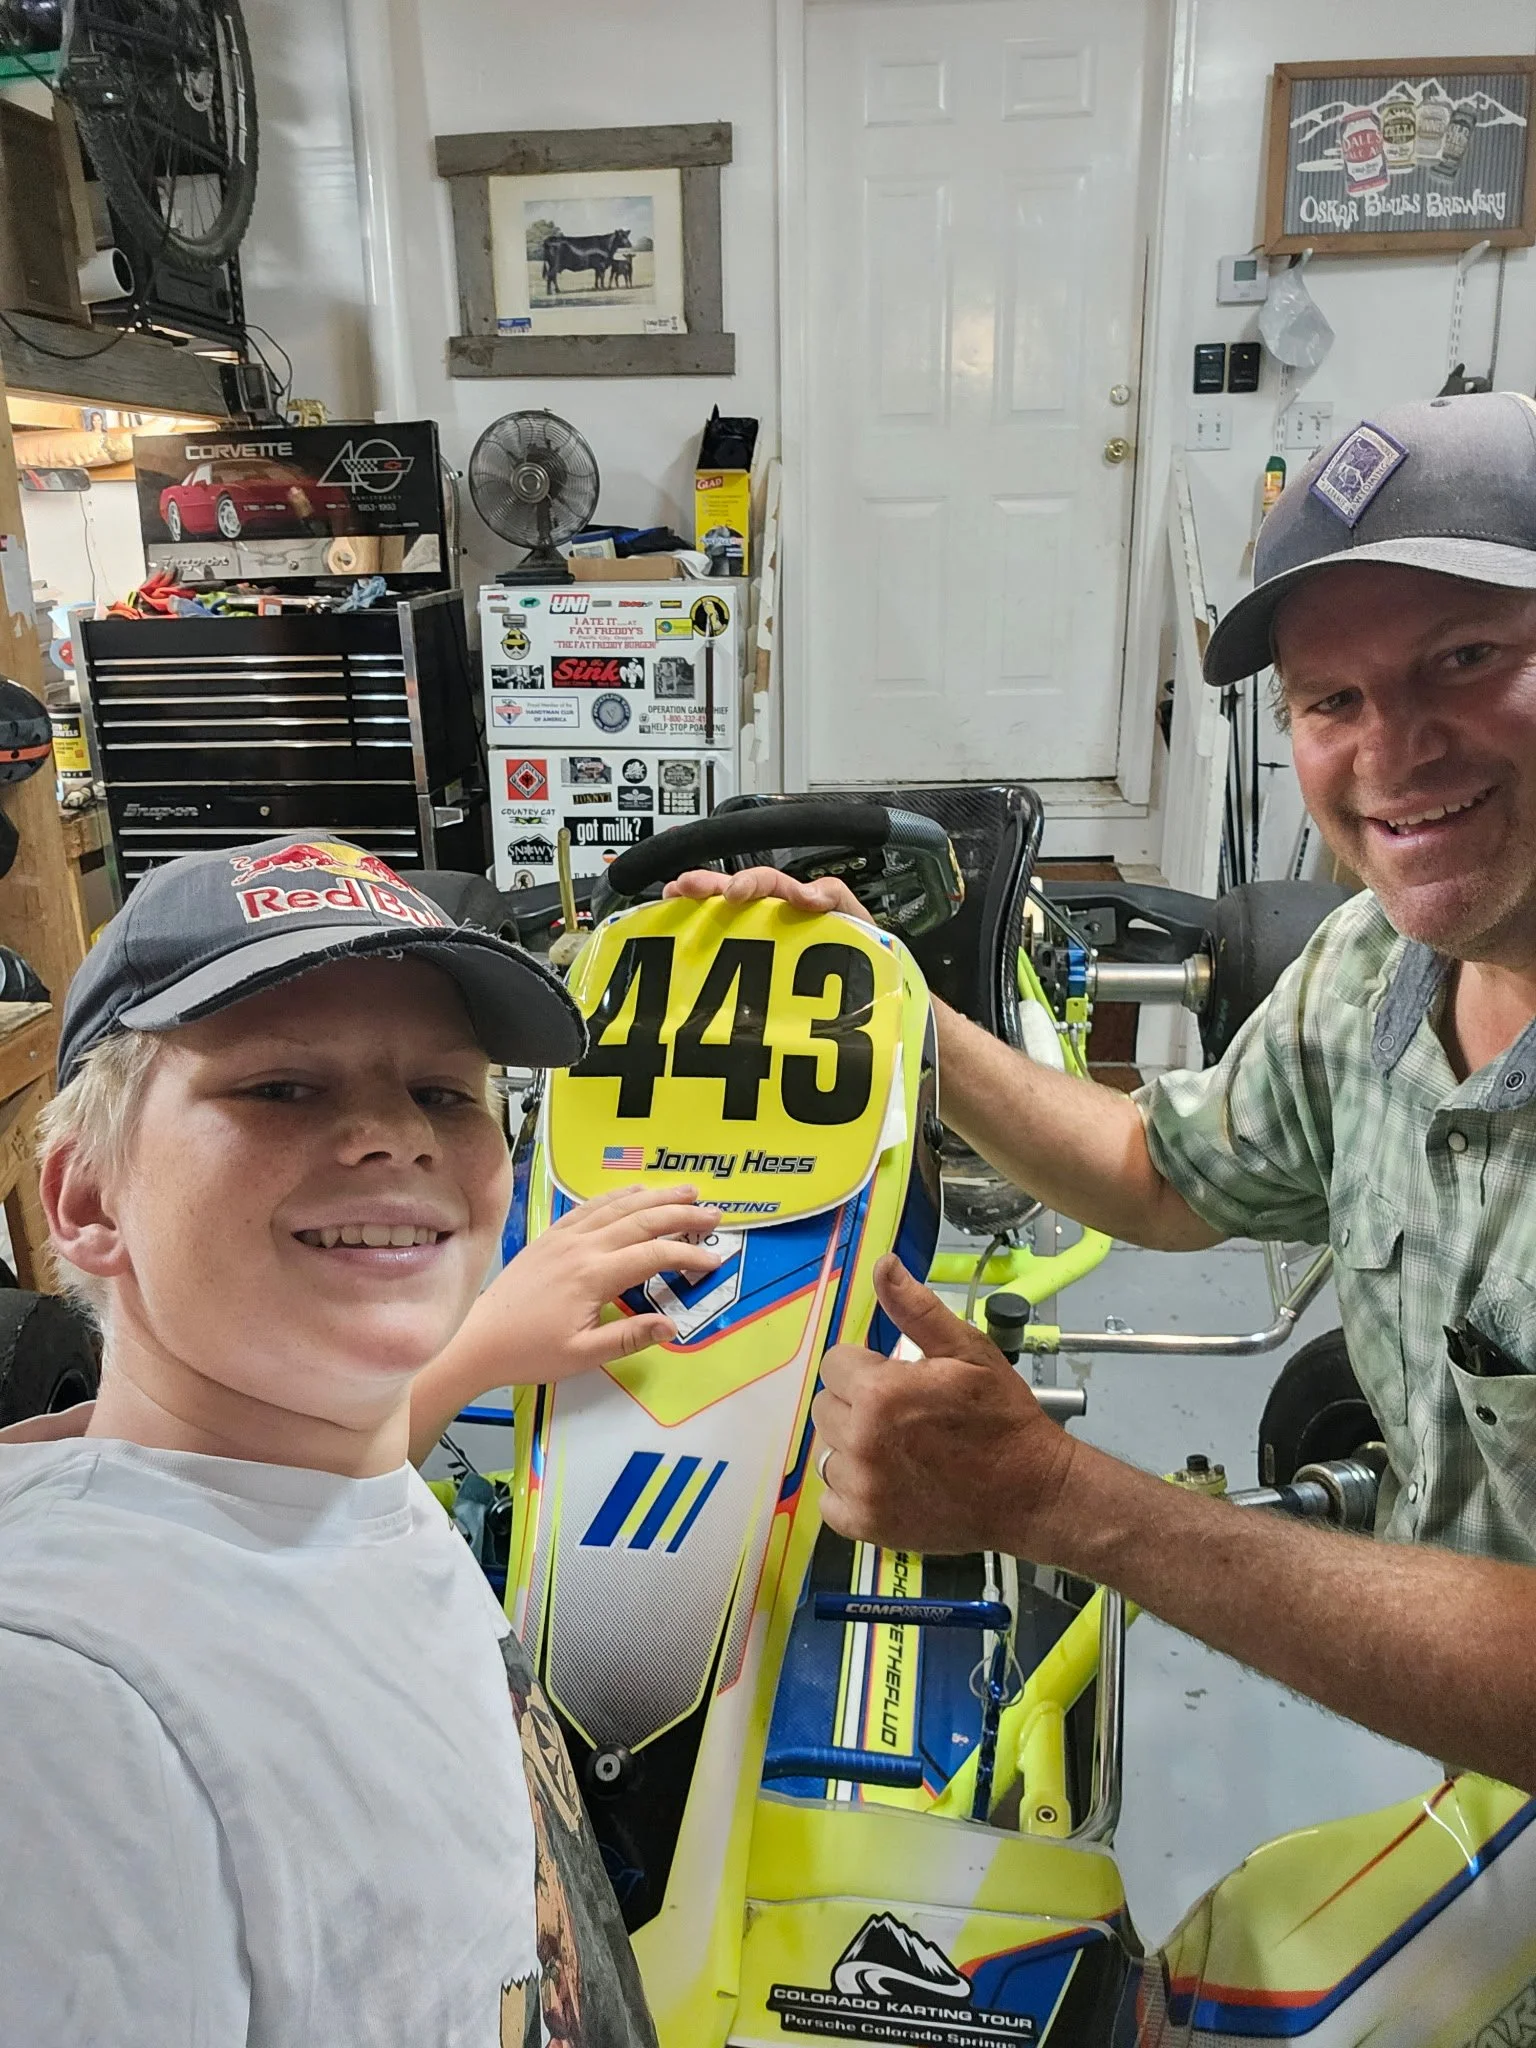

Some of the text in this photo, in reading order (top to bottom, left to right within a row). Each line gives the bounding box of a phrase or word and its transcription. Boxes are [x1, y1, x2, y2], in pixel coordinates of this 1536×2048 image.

[1300, 189, 1506, 228] OSKAR BLUES BREWERY
[185, 442, 293, 460] CORVETTE
[697, 479, 722, 490] GLAD
[551, 594, 589, 613] UNI
[569, 627, 644, 635] FAT FREDDY'S
[582, 617, 604, 626] ATE
[574, 641, 591, 649] FAT
[553, 658, 620, 681] Sink
[648, 705, 686, 714] OPERATION
[687, 706, 706, 714] GAM
[652, 723, 668, 731] HELP
[501, 808, 556, 816] COUNTRY CAT
[577, 818, 642, 845] got milk?
[240, 877, 446, 928] Red Bul
[569, 936, 875, 1126] 443
[645, 1147, 817, 1178] Jonny Hess
[774, 1988, 1032, 2029] COLORADO KARTING TOUR
[784, 2013, 857, 2032] Porsche
[861, 2023, 943, 2042] Colorado
